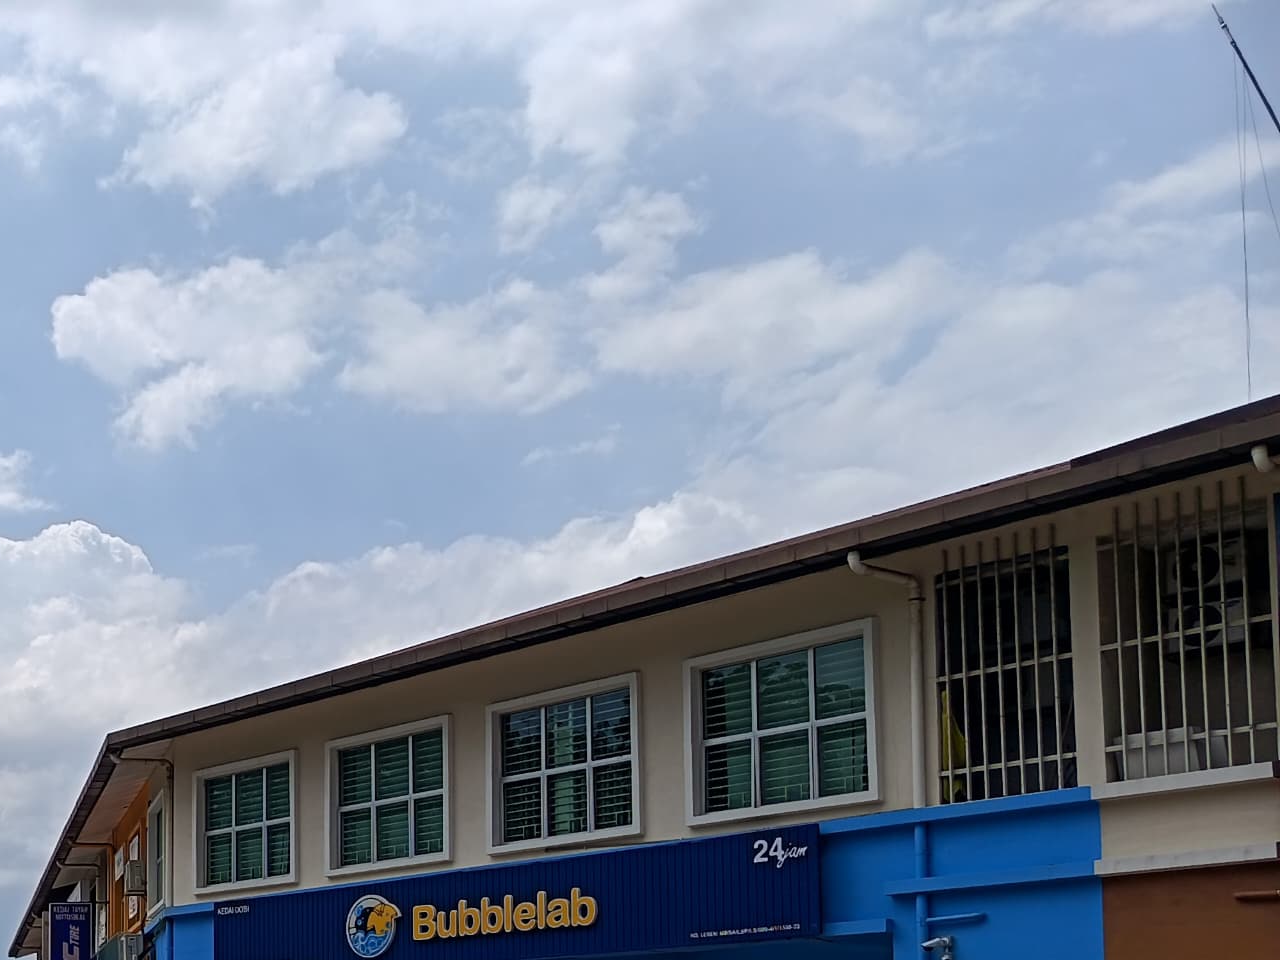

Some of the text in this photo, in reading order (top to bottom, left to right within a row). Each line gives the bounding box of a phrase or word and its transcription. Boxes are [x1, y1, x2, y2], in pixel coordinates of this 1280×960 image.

[753, 837, 808, 868] 24 jam
[412, 887, 598, 941] Bubblelab
